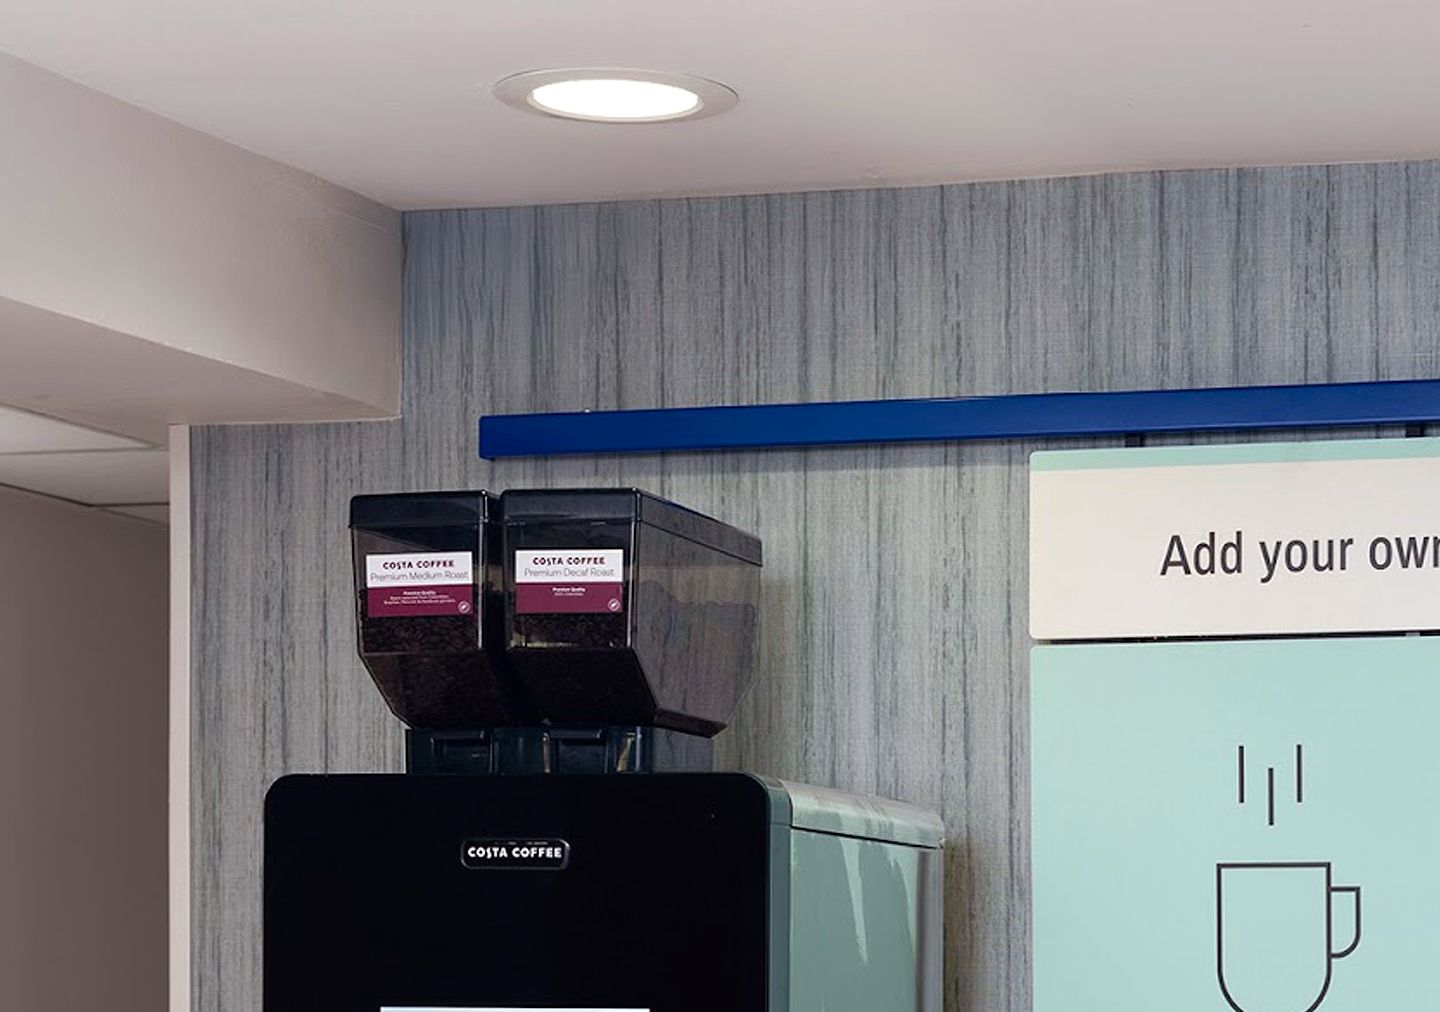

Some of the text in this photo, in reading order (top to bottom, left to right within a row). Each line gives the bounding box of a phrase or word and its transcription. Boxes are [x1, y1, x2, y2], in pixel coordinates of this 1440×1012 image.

[533, 556, 606, 566] COSTA COFFEE
[1160, 531, 1243, 576] Add
[1258, 537, 1354, 584] your
[383, 559, 455, 570] COSTA COFFEE
[370, 572, 408, 582] Premium
[409, 571, 443, 581] Medium
[524, 567, 615, 578] Premium Decaf Roast
[467, 846, 562, 859] COSTA COFFEE
